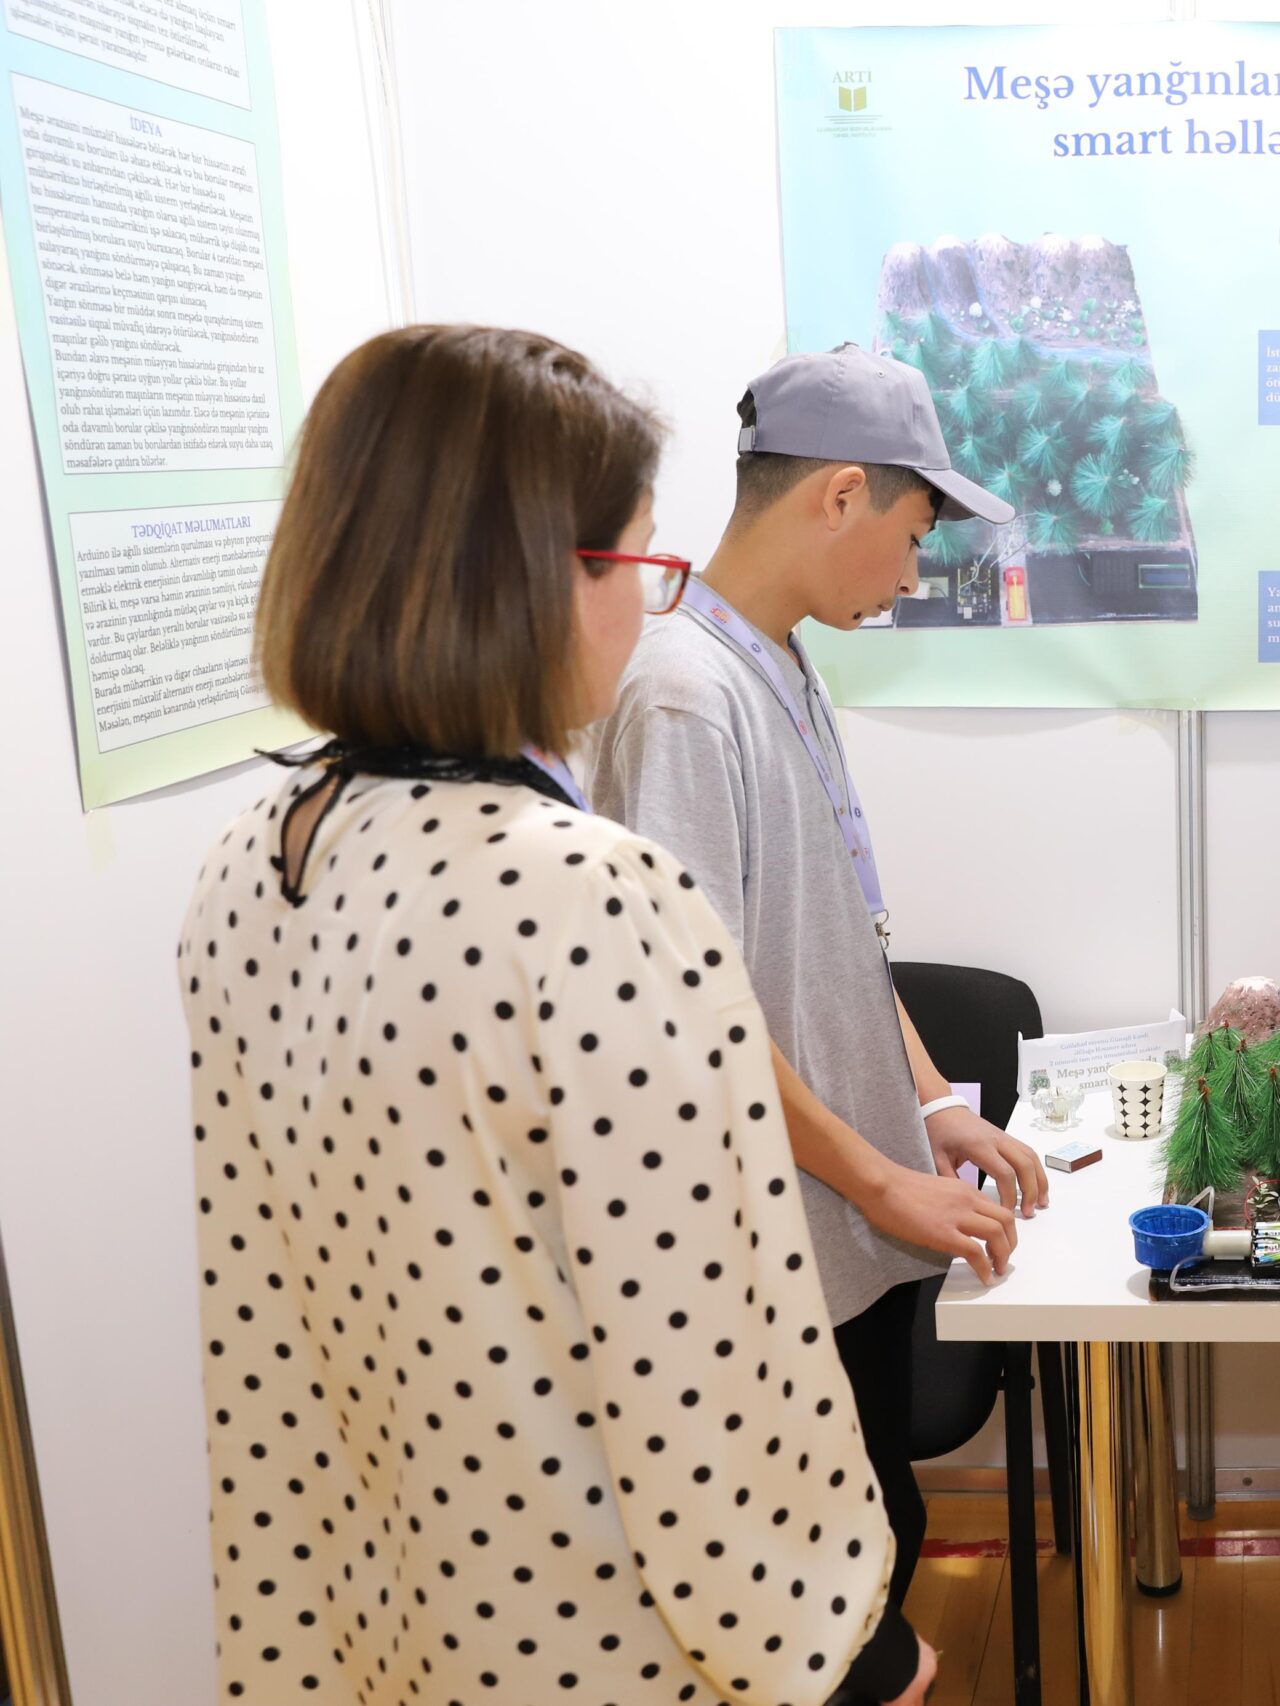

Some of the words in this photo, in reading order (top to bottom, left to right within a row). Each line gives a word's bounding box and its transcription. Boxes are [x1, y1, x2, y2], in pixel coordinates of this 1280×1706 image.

[963, 66, 1075, 110] Meşə
[129, 116, 162, 137] İDEYA
[1053, 125, 1172, 157] smart
[62, 421, 79, 432] oda
[131, 521, 183, 538] TƏDQİQAT
[184, 516, 251, 533] MƏLUMATLARI
[76, 549, 110, 562] Arduino
[111, 547, 121, 558] ilə
[116, 562, 139, 574] təmin
[113, 577, 142, 592] elektrik
[114, 631, 125, 643] Bu
[89, 649, 131, 665] doldurmaq
[91, 667, 119, 681] həmişə
[94, 683, 121, 698] Burada
[1057, 1068, 1085, 1079] Meşə
[1079, 1078, 1109, 1090] smart
